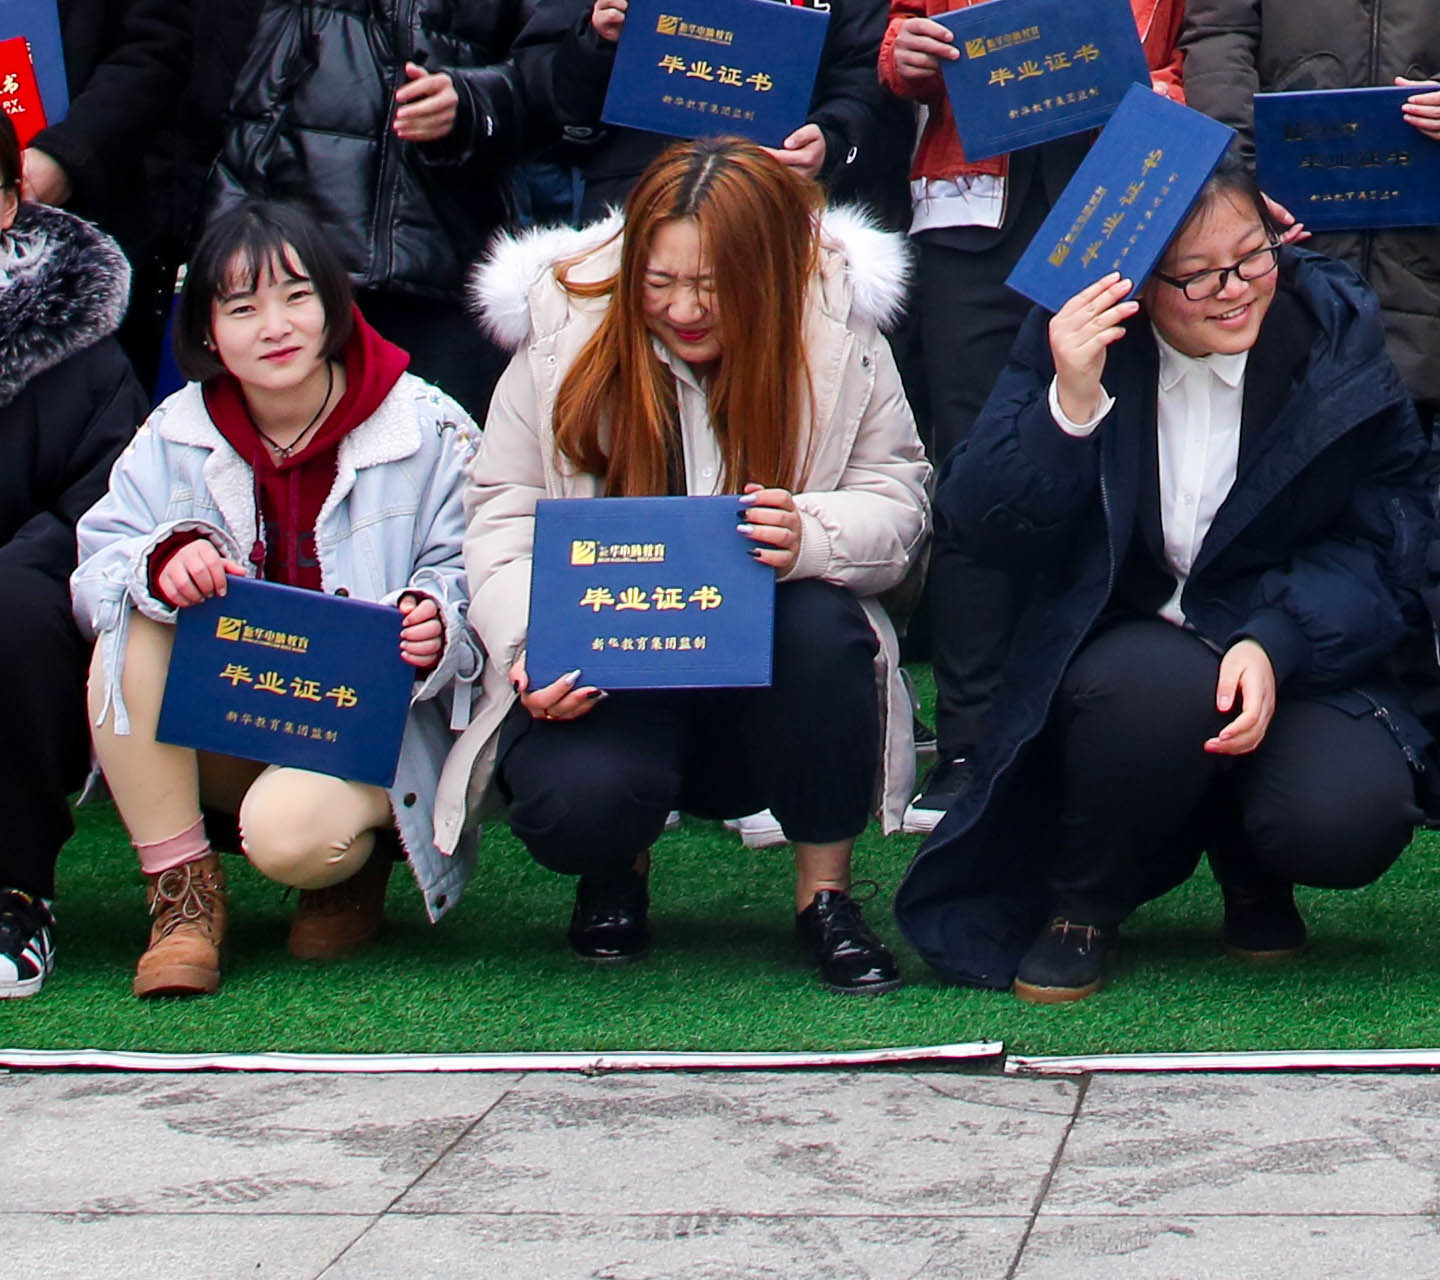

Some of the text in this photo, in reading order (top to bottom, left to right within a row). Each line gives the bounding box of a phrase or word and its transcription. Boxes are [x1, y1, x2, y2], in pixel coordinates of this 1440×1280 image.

[657, 54, 773, 91] 毕业证书
[987, 45, 1100, 87] 毕业证书
[1081, 148, 1163, 269] 毕业证书
[579, 586, 723, 612] 毕业证书
[243, 626, 310, 650] 新华电脑教育
[219, 663, 359, 708] 毕业证书
[226, 711, 338, 743] 新华教育集团监制
